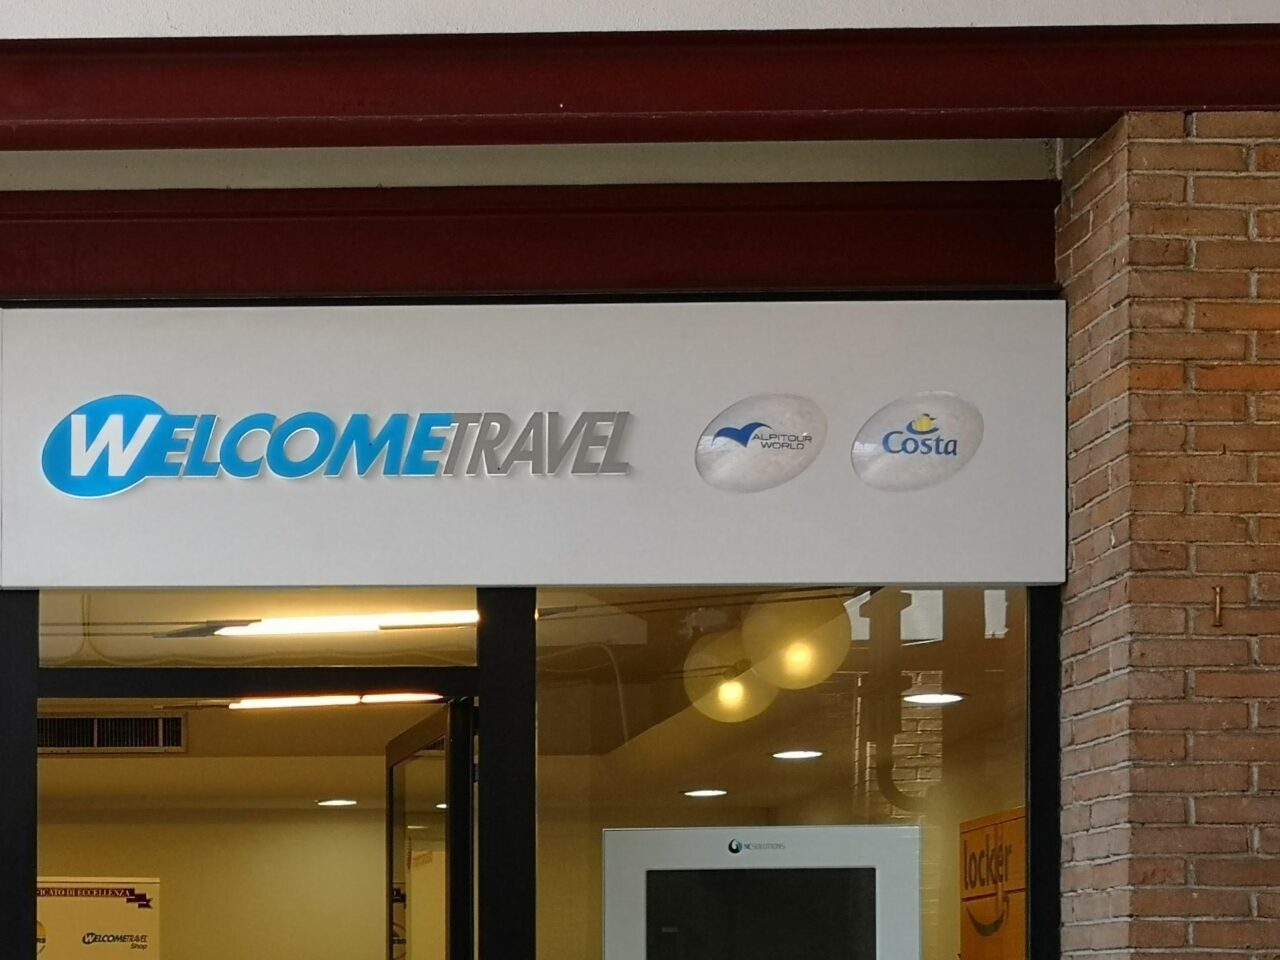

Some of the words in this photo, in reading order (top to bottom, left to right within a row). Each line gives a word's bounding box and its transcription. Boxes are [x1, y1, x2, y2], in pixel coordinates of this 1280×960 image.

[61, 410, 633, 479] WELCOMETRAVEL
[752, 431, 813, 445] ALPITOUR
[760, 440, 805, 450] WORLD
[882, 430, 958, 458] Costa
[963, 833, 1013, 890] locker
[77, 889, 130, 897] ECCELLENZA
[130, 943, 148, 951] Shop
